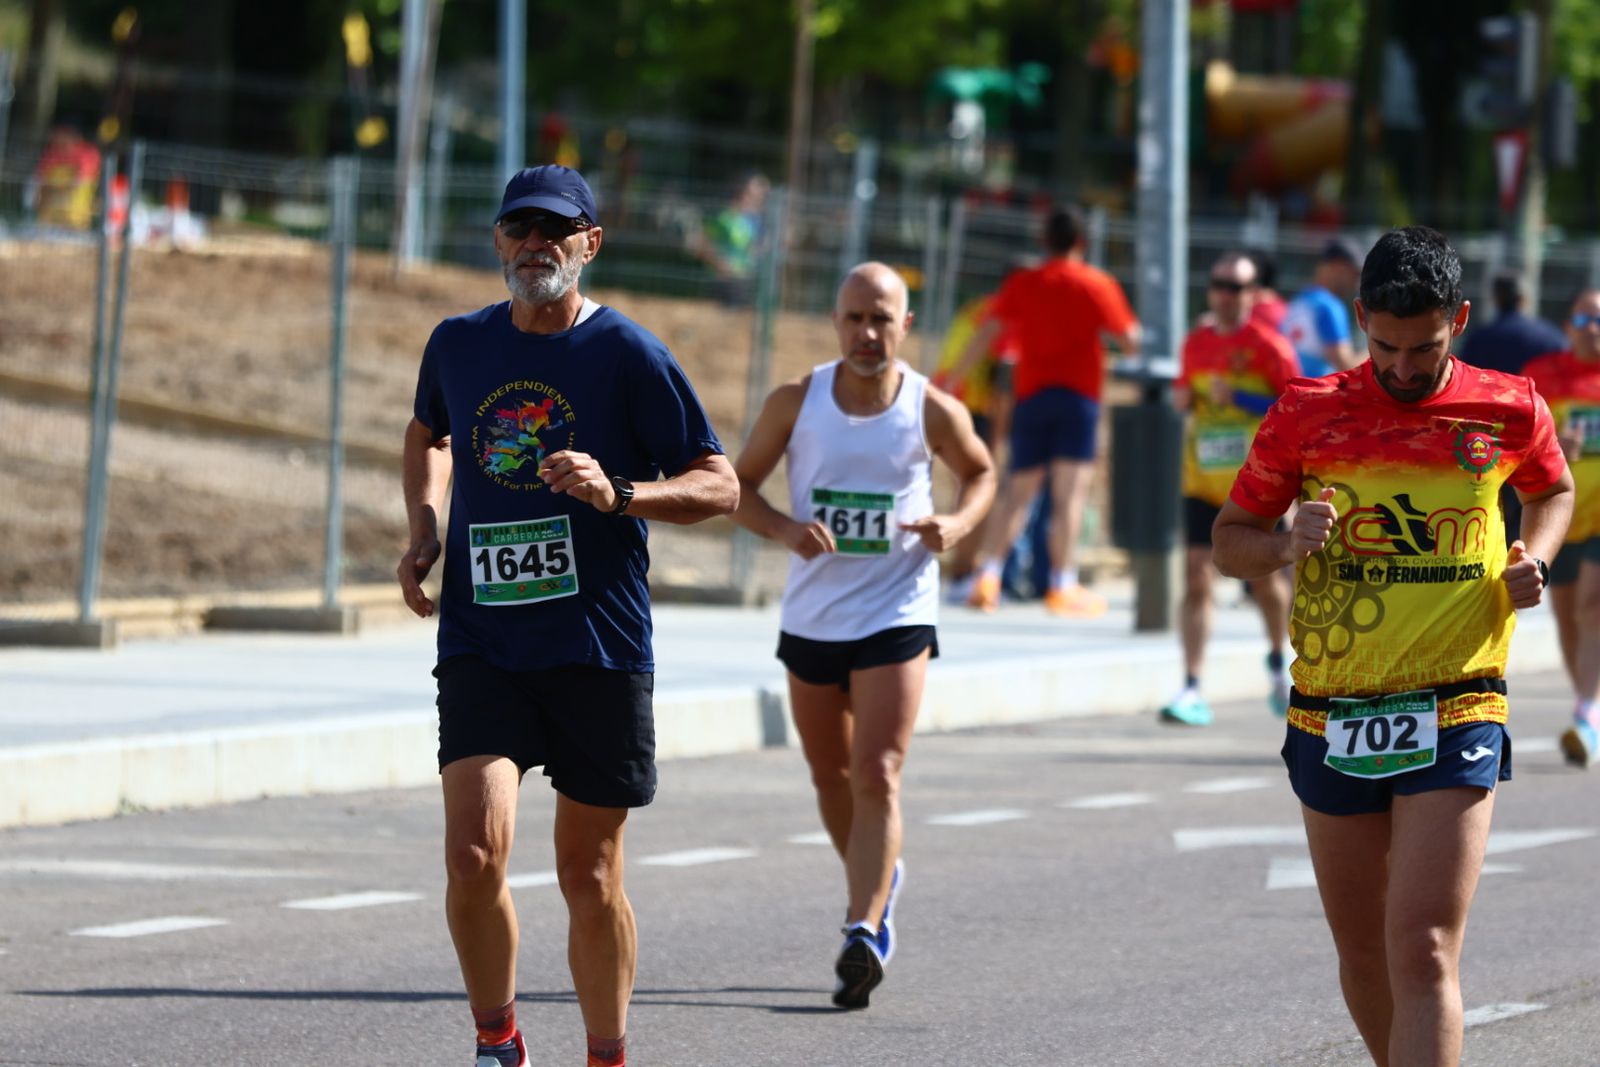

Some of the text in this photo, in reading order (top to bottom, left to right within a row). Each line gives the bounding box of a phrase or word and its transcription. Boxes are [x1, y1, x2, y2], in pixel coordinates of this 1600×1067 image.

[475, 380, 576, 423] INDEPENDIENTE
[503, 481, 520, 490] For
[524, 482, 544, 491] The
[494, 531, 541, 544] CARRERA
[476, 540, 570, 583] 1645
[1338, 562, 1486, 584] SAN FERNANDO 2026
[1354, 702, 1404, 716] CARRERA
[1342, 714, 1420, 756] 702
